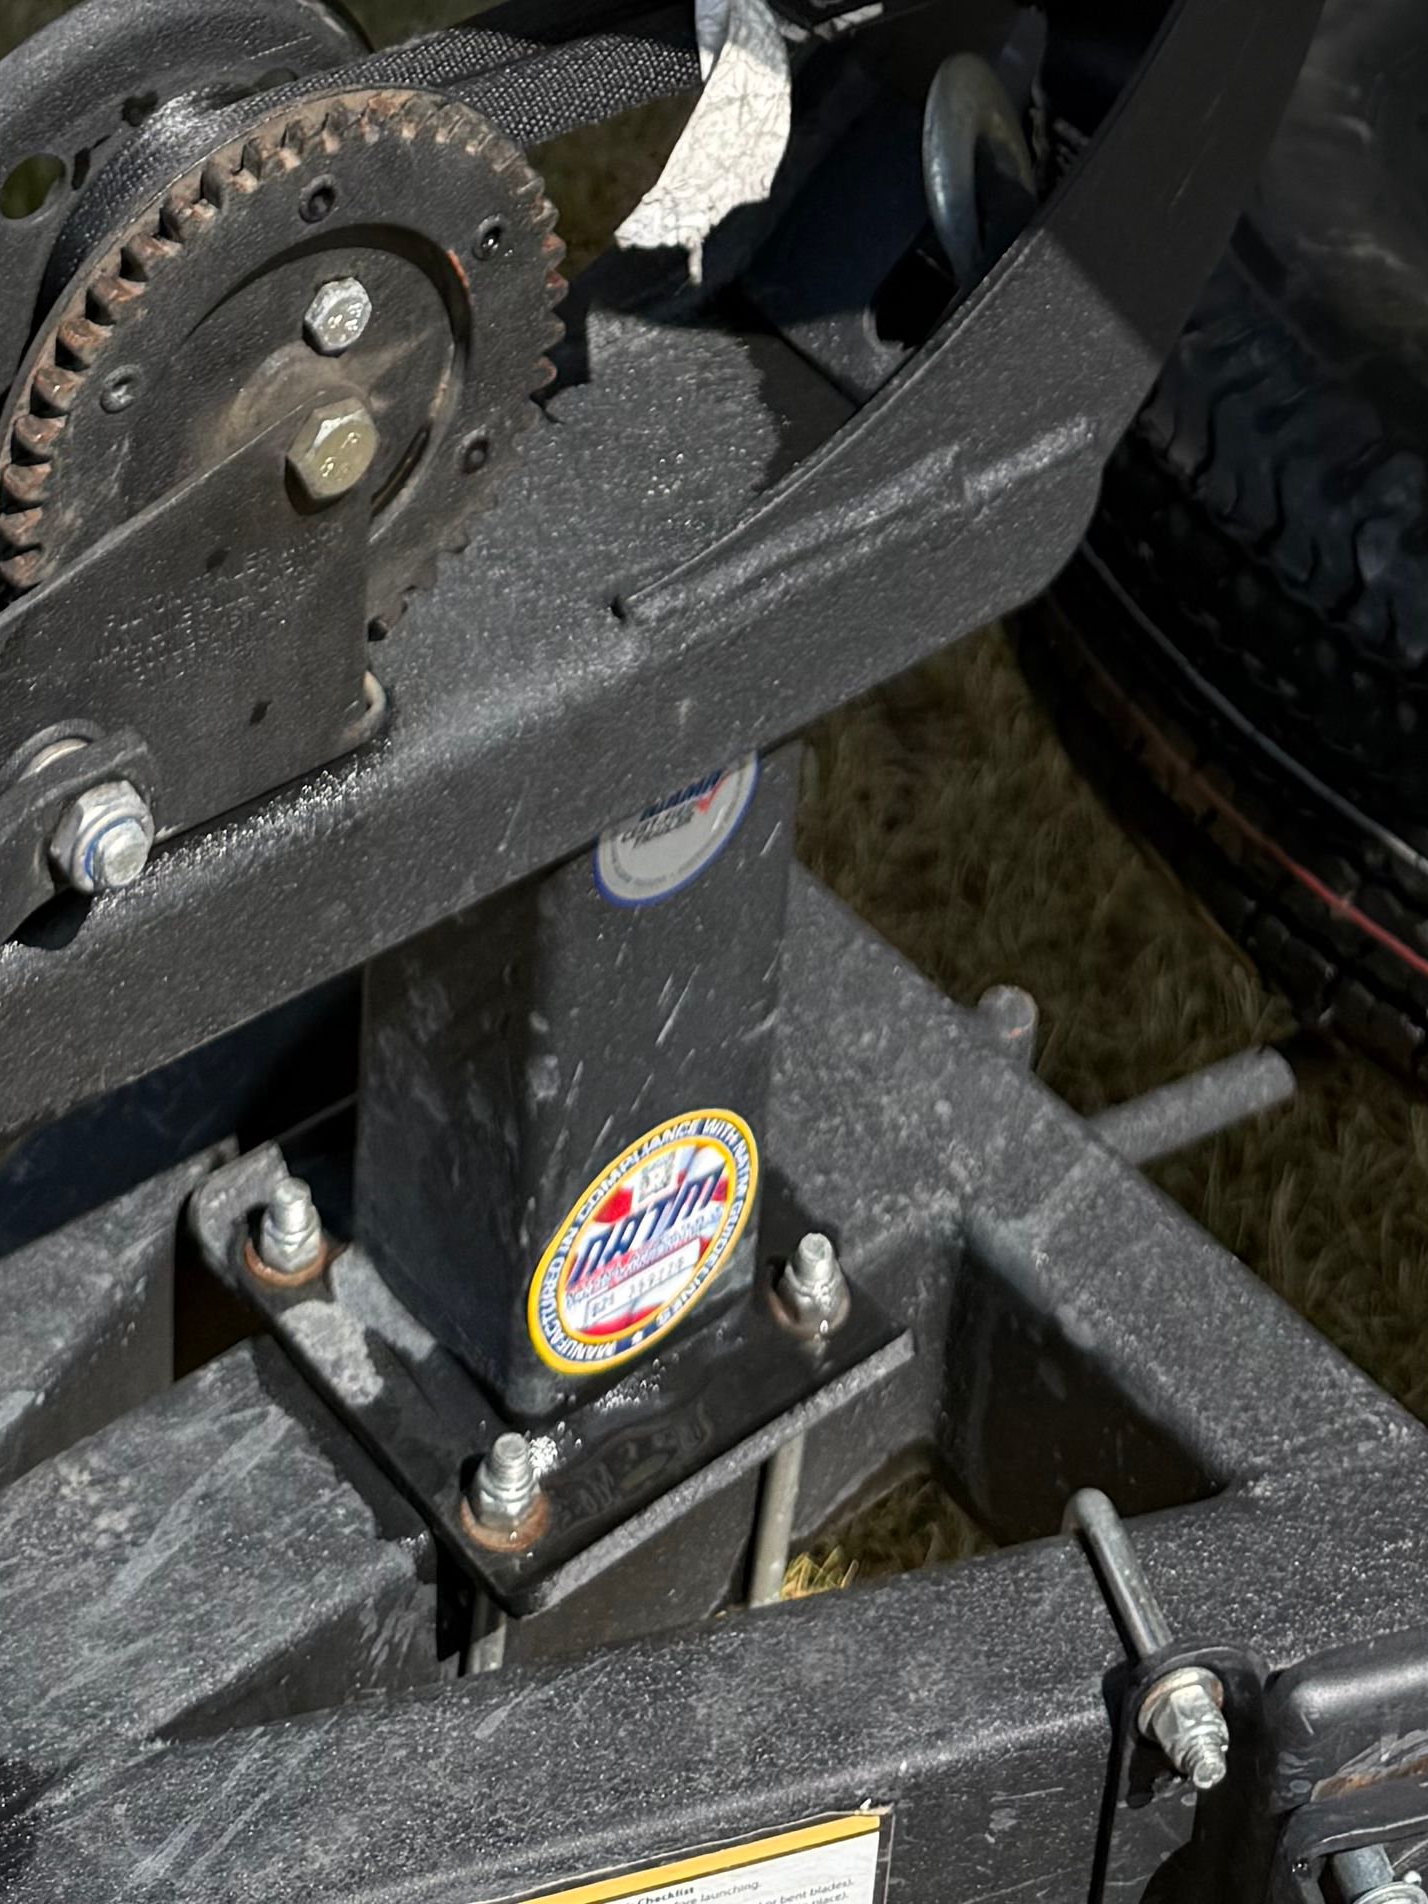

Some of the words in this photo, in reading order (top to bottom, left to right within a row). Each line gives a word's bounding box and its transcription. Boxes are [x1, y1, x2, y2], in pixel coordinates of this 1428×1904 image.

[577, 1120, 702, 1223] COMPLIANCE
[703, 1118, 740, 1149] WITH
[558, 1226, 580, 1257] IN
[567, 1162, 726, 1287] NATM
[656, 1198, 743, 1326] GUIDELINES
[539, 1258, 616, 1361] MANUFACTURED
